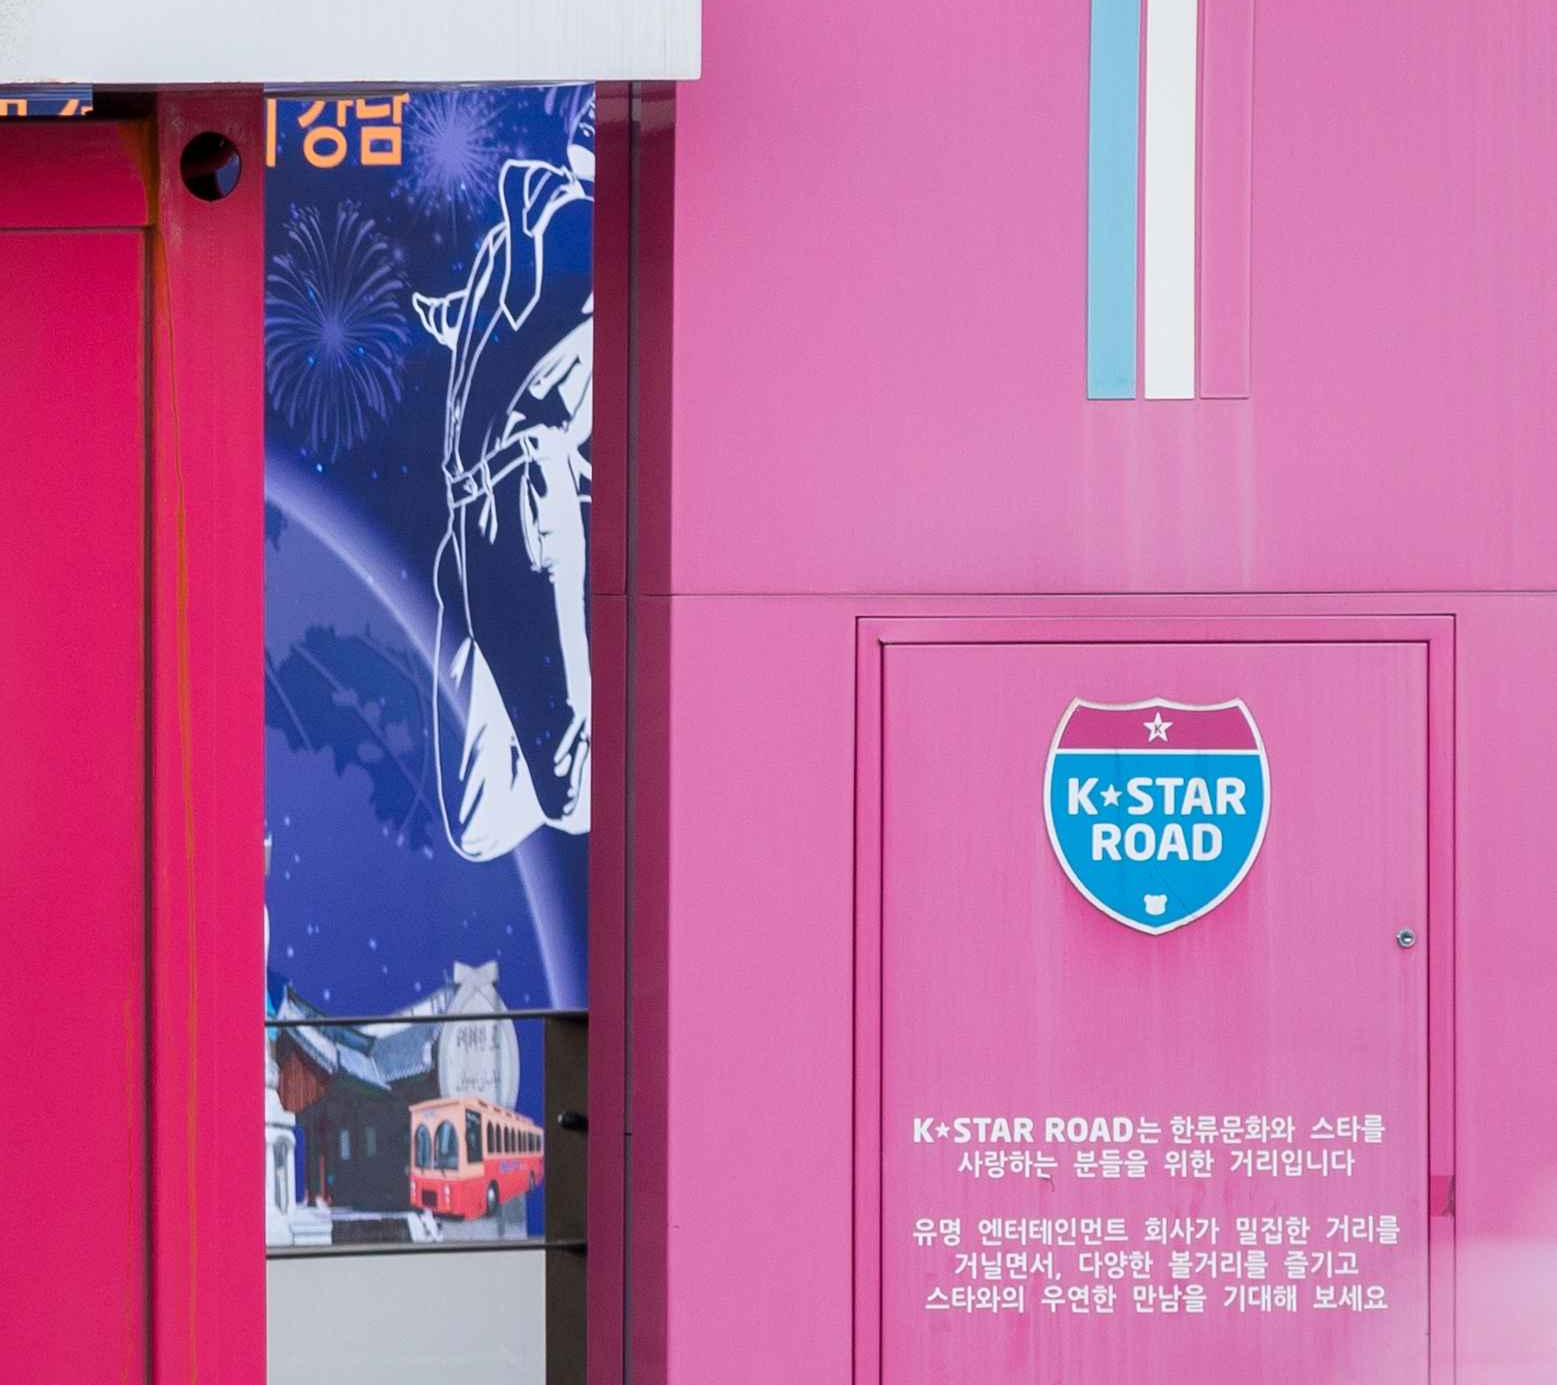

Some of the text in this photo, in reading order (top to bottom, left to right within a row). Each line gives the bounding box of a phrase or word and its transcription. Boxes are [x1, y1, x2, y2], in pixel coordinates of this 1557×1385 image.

[1091, 822, 1223, 861] ROAD
[1169, 1115, 1297, 1145] 한류문화와
[1310, 1114, 1387, 1145] 스타를
[958, 1148, 1357, 1180] 사랑하는 분들을 위한 거리입니다
[912, 1214, 1402, 1247] 유명 엔터테인먼트 회사가 밀집한 거리를
[954, 1249, 1360, 1282] 거닐면서, 다양한 볼거리를 즐기고
[925, 1283, 1390, 1315] 스타와의 우연한 만남을 기대해 보세요
